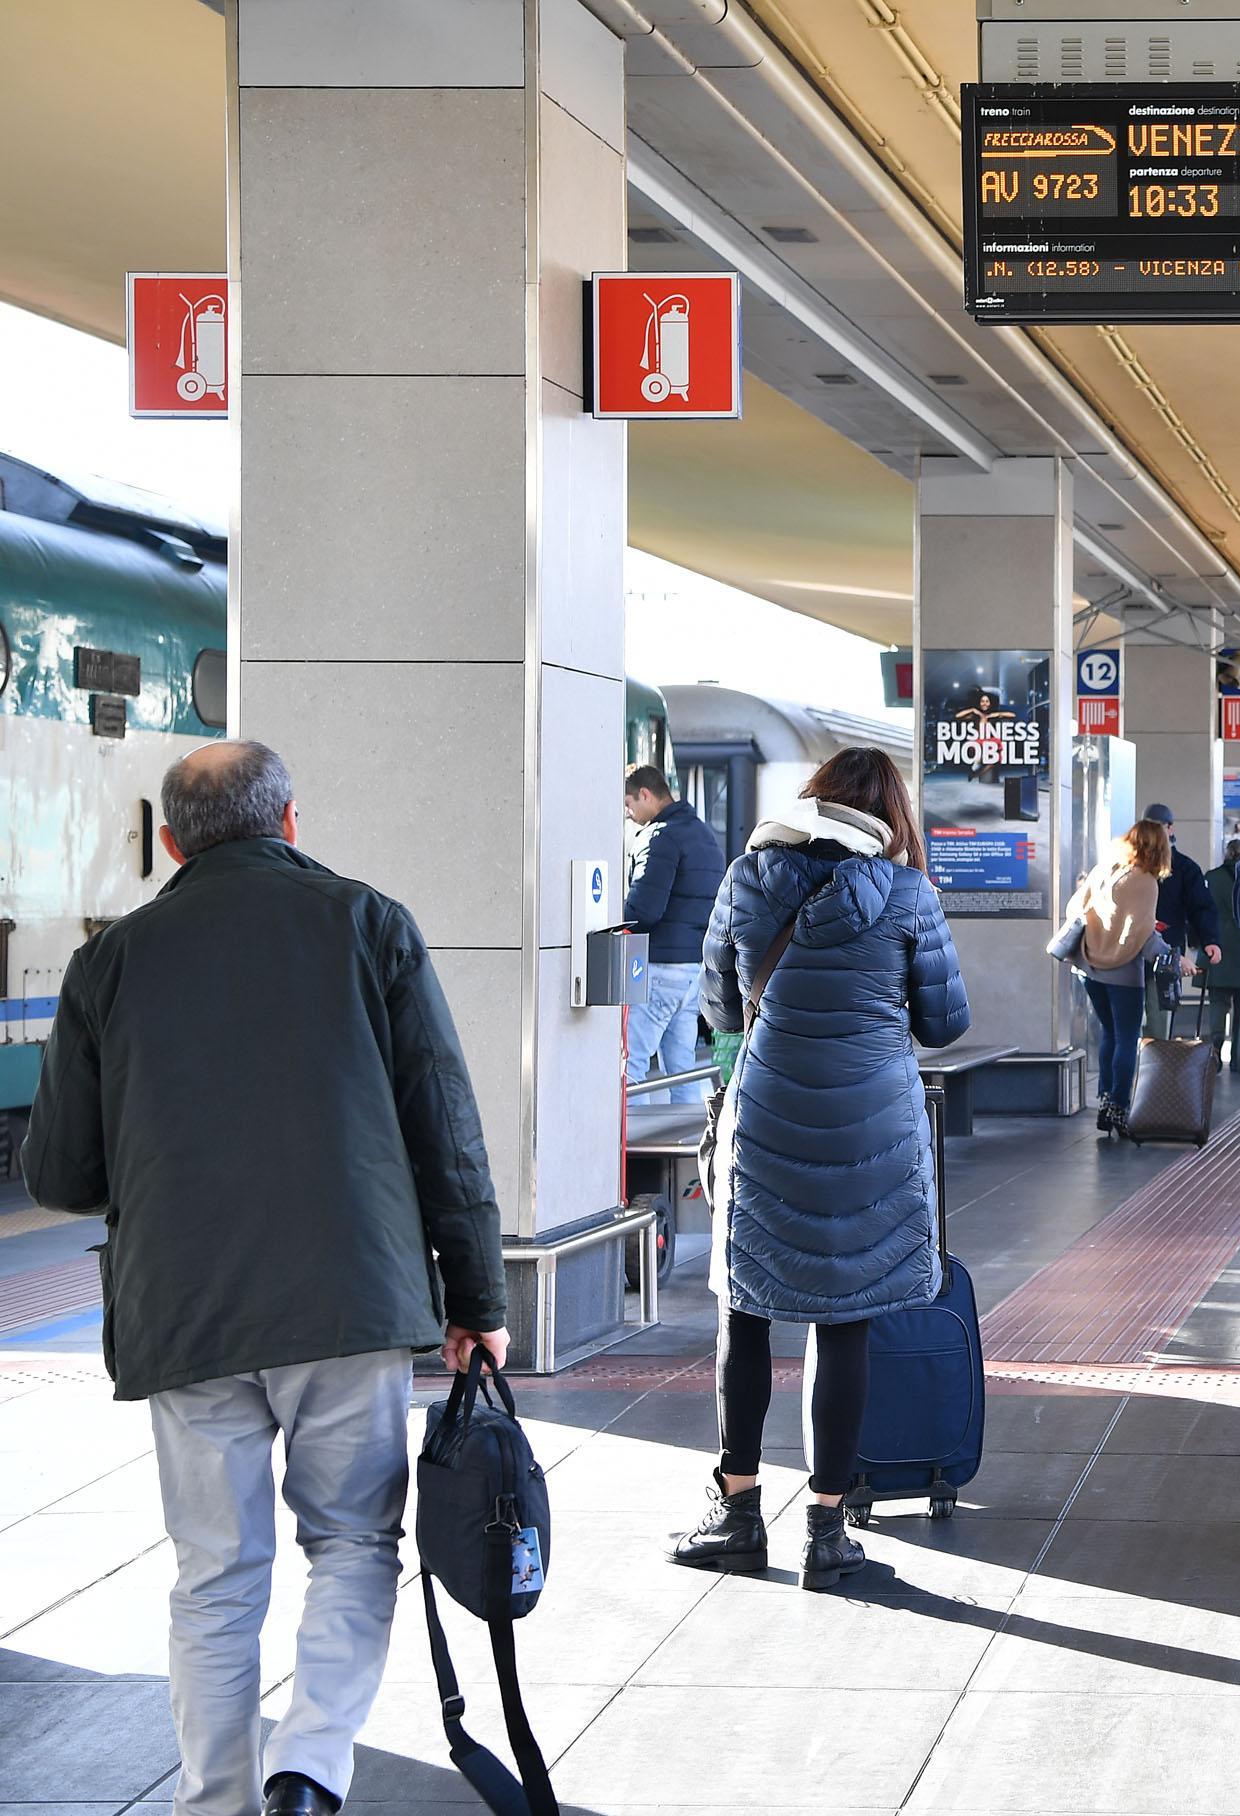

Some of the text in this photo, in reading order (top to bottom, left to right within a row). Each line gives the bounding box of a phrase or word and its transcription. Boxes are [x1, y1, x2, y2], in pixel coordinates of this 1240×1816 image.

[980, 107, 1031, 116] treno train
[1128, 105, 1240, 116] destinazione destination
[984, 133, 1089, 146] FRECCIAROSSA
[1129, 166, 1222, 178] partenza departure
[981, 171, 1098, 203] AV 9723
[1129, 185, 1218, 217] 10:33
[983, 242, 1095, 253] informazioni information
[986, 261, 1013, 276] .N.
[1027, 261, 1100, 276] (12.58)
[1139, 260, 1225, 276] VICENZA
[1085, 662, 1112, 681] 12
[937, 721, 1040, 741] BUSINESS
[937, 741, 1040, 765] MOBILE
[939, 876, 953, 884] TIM
